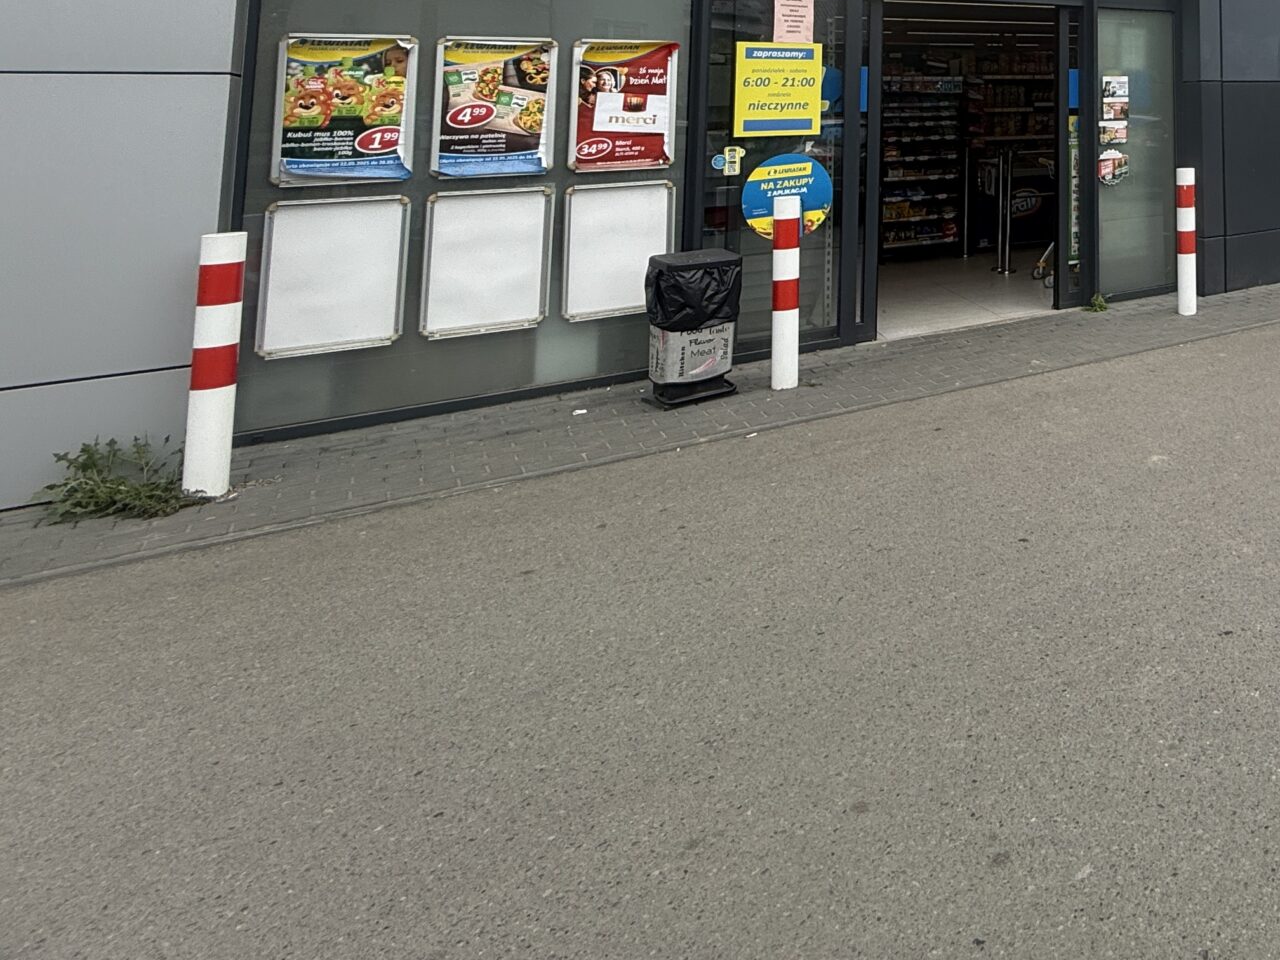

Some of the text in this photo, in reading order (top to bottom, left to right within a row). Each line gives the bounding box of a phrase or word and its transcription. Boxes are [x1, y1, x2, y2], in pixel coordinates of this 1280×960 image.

[752, 50, 807, 59] zapraszamy:
[648, 67, 664, 78] maja
[629, 75, 650, 85] Dzień
[743, 77, 771, 87] 6:00
[781, 77, 816, 87] 21:00
[748, 100, 809, 112] nieczynne
[608, 114, 657, 125] merci
[761, 177, 815, 190] NA ZAKUPY
[690, 346, 716, 358] Meat
[678, 346, 686, 377] Kitchen
